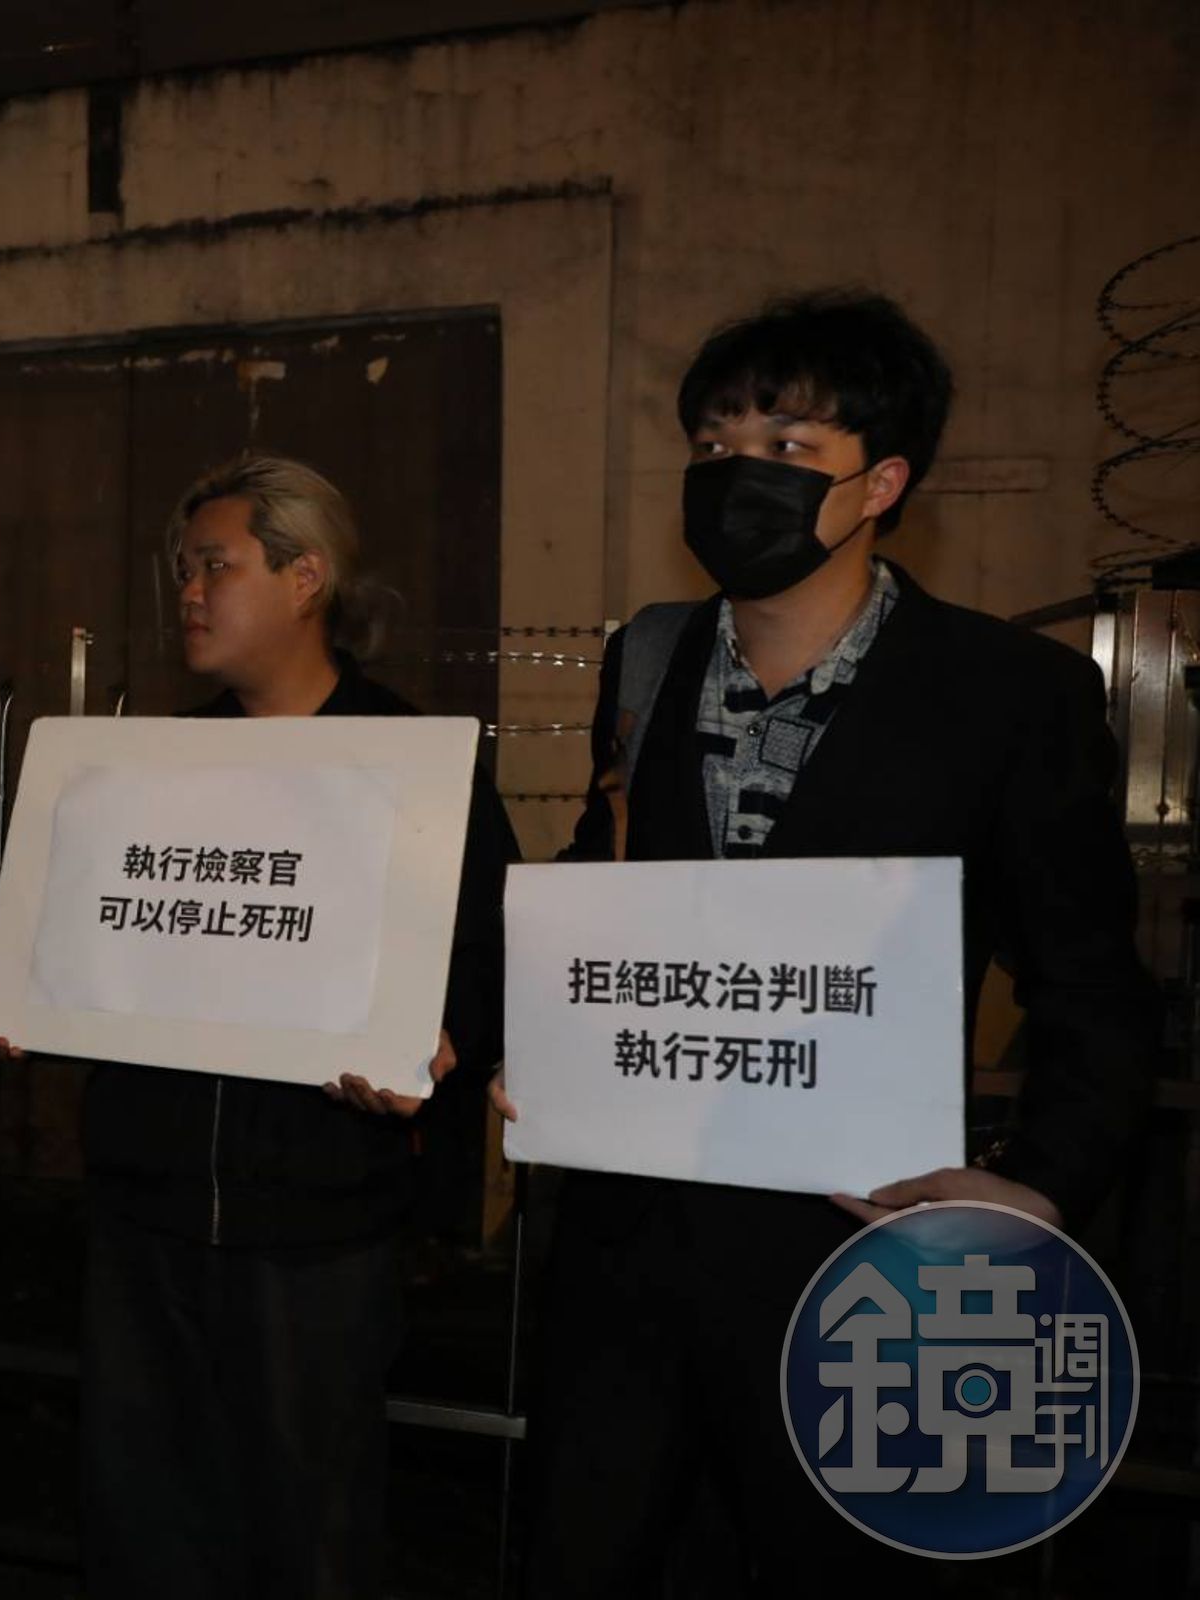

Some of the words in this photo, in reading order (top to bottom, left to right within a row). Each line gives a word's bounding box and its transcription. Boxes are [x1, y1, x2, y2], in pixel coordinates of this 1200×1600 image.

[122, 843, 303, 888] 執行檢察官
[99, 895, 314, 943] 可以停止死刑
[567, 957, 878, 1018] 拒絕政治判斷
[613, 1028, 818, 1090] 執行死刑
